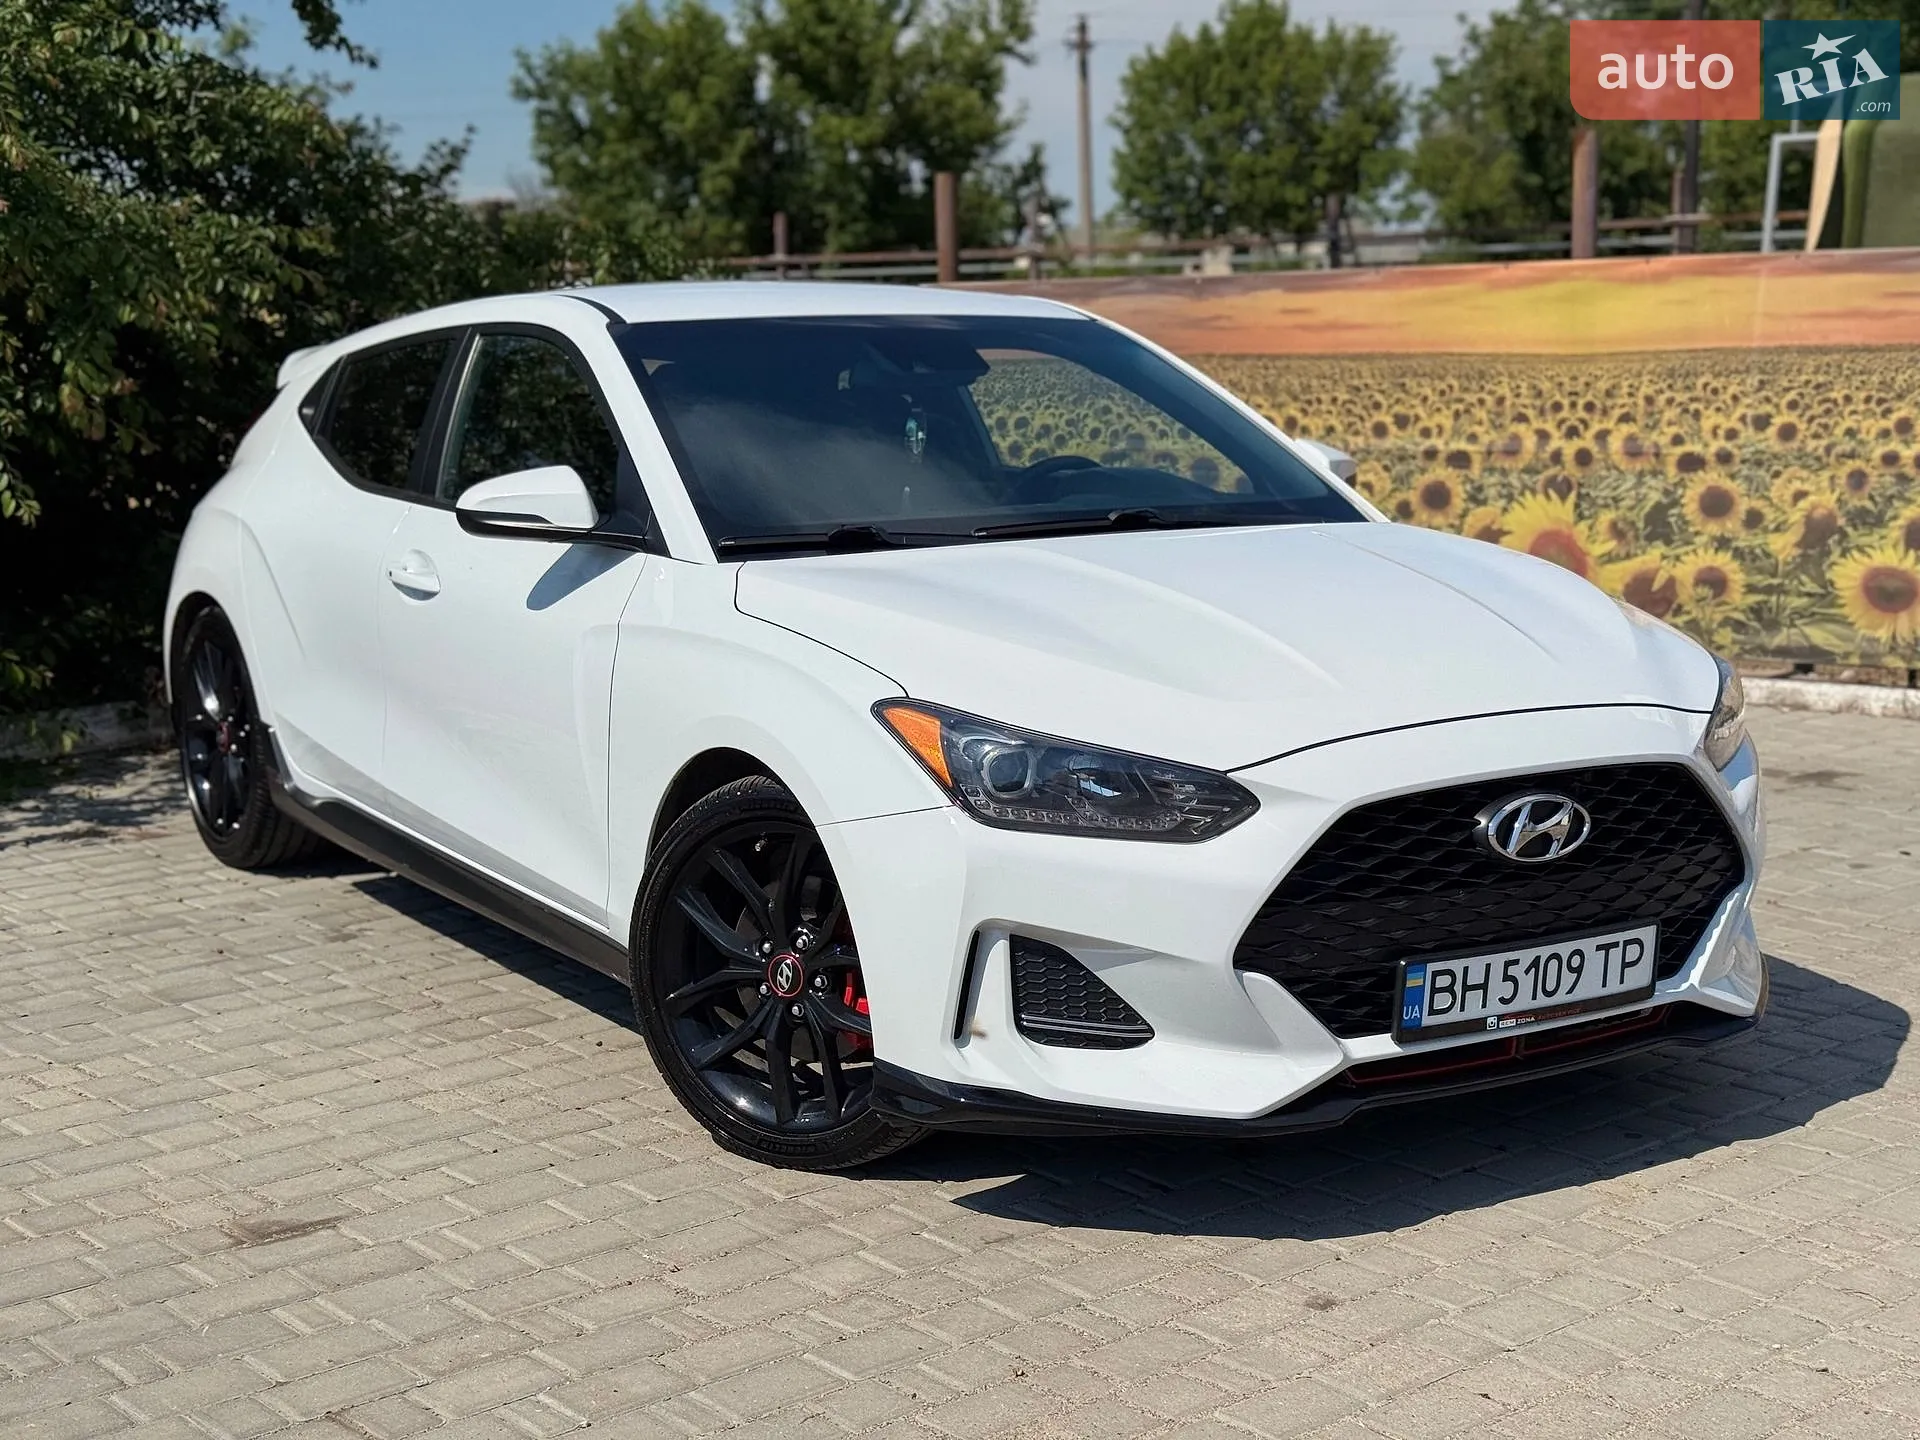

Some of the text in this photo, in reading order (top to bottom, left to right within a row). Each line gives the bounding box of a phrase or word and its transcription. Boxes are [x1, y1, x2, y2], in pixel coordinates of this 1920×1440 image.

[1427, 937, 1645, 1017] BH 5109 TP
[1403, 1005, 1421, 1020] UA
